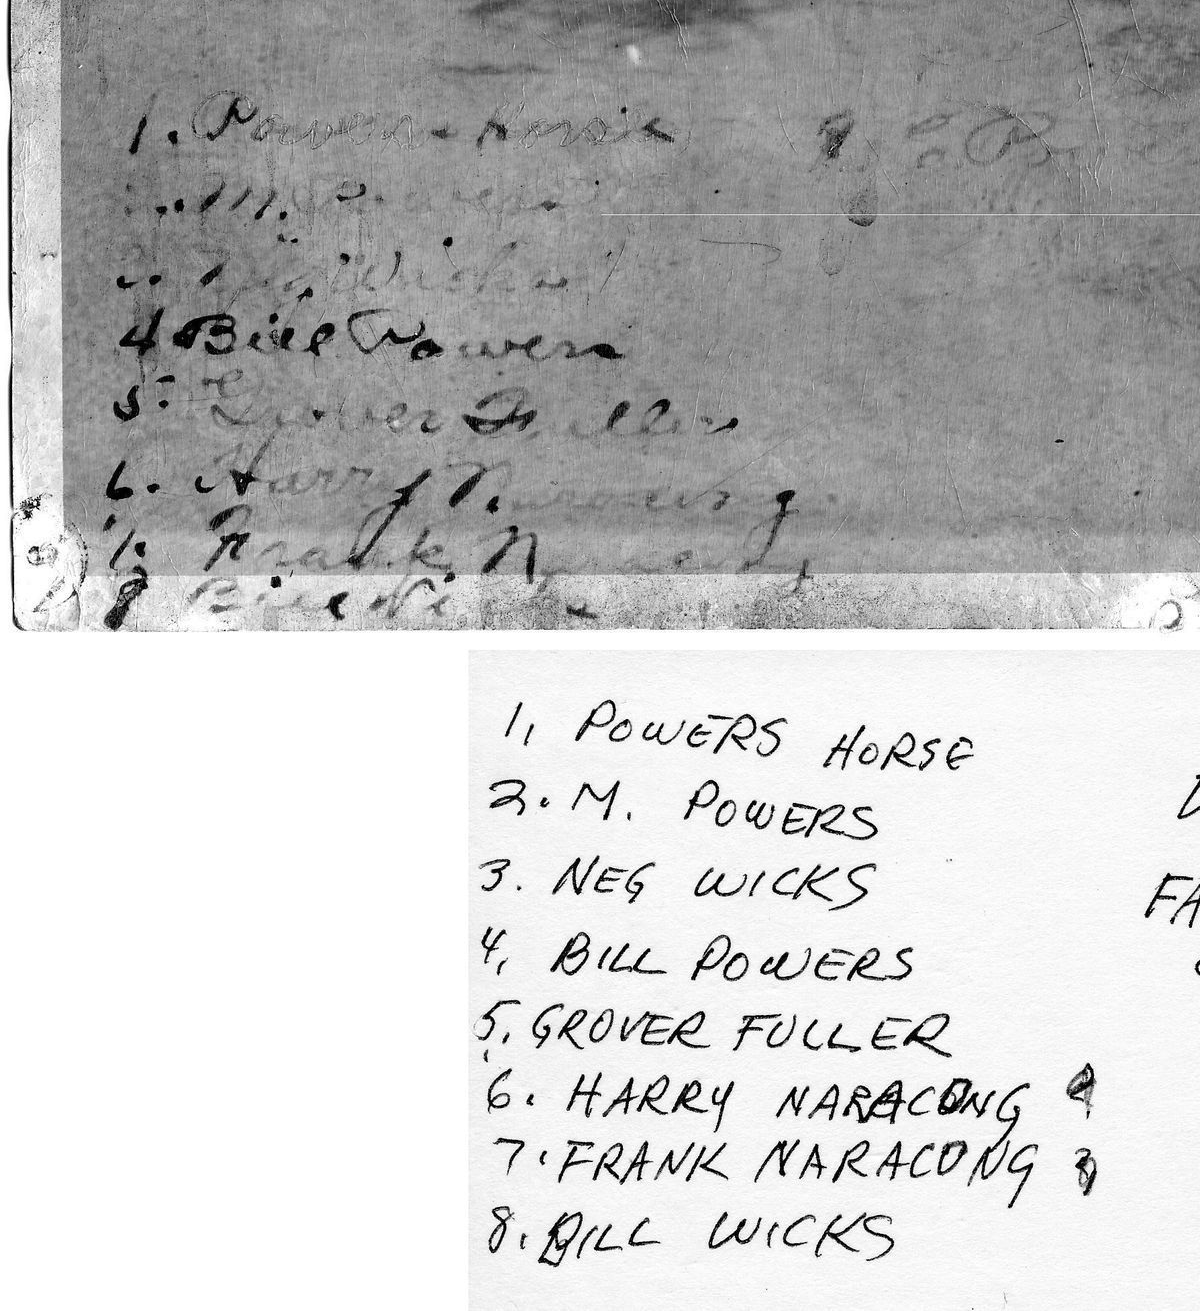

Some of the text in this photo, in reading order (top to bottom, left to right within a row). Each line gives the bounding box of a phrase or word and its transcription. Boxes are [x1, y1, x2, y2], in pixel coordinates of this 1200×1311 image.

[574, 699, 789, 758] POWERS
[822, 724, 975, 772] HORSE
[571, 780, 632, 822] M.
[683, 779, 879, 841] POWERS
[551, 854, 656, 905] NEG
[693, 862, 877, 912] WICKS
[549, 931, 668, 977] BILL
[690, 934, 914, 982] POWERS
[531, 1002, 711, 1051] GROVER
[733, 1012, 953, 1059] FULLER
[565, 1071, 735, 1134] HARRY
[557, 1139, 729, 1186] FRANK
[753, 1137, 1039, 1209] NARACONG
[537, 1211, 661, 1268] BILL
[707, 1211, 895, 1262] WICKS
